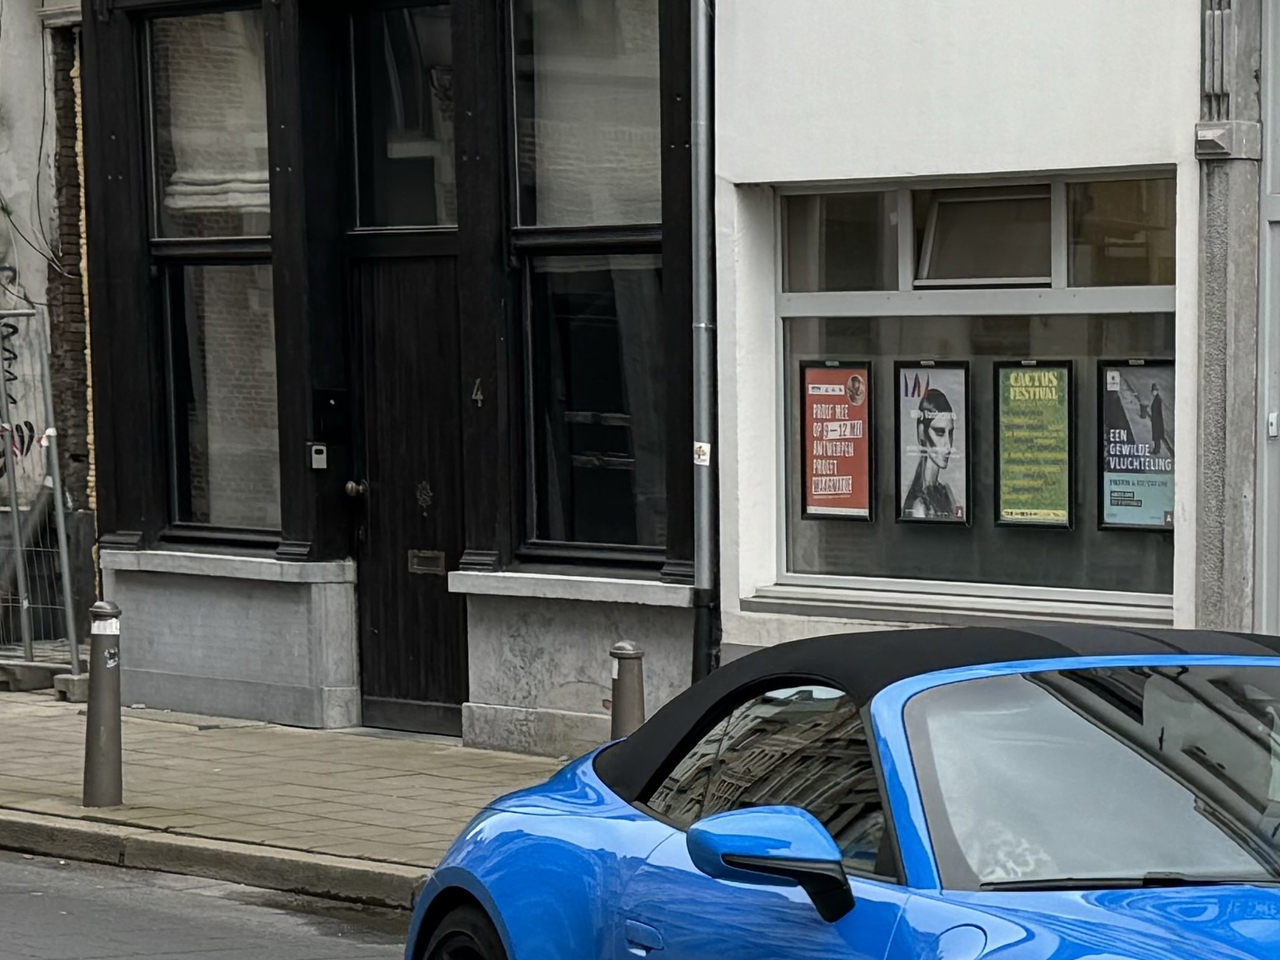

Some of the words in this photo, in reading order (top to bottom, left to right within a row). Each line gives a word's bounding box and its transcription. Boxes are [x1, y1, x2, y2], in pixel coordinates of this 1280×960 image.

[1010, 371, 1058, 387] CACTUS
[472, 378, 484, 407] 4
[1010, 387, 1059, 401] FESTIVAL
[812, 422, 822, 437] OP
[1109, 429, 1127, 442] EEN
[1109, 443, 1150, 456] GEWILDE
[1108, 456, 1172, 472] VLUCHTELING
